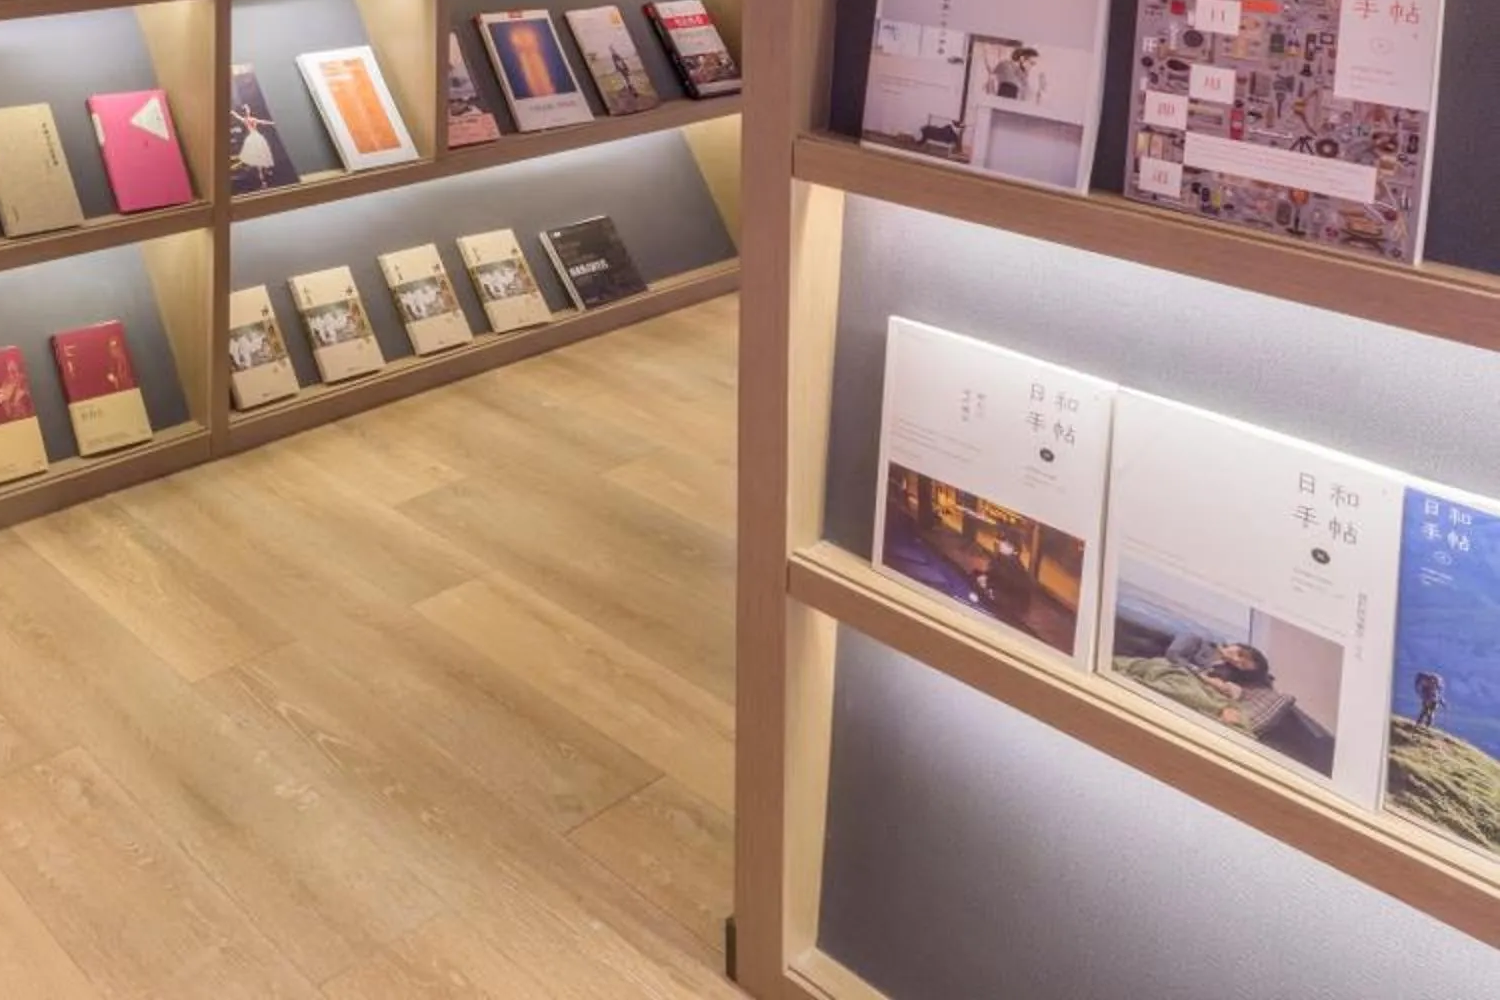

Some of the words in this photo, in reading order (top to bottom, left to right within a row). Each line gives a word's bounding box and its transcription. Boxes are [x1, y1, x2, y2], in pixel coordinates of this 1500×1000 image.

[1030, 382, 1080, 413] 日和
[1026, 411, 1076, 446] 手帖
[1299, 472, 1360, 508] 日和
[1293, 504, 1358, 545] 手帖
[1424, 499, 1472, 526] 日和
[1422, 522, 1469, 552] 手帖
